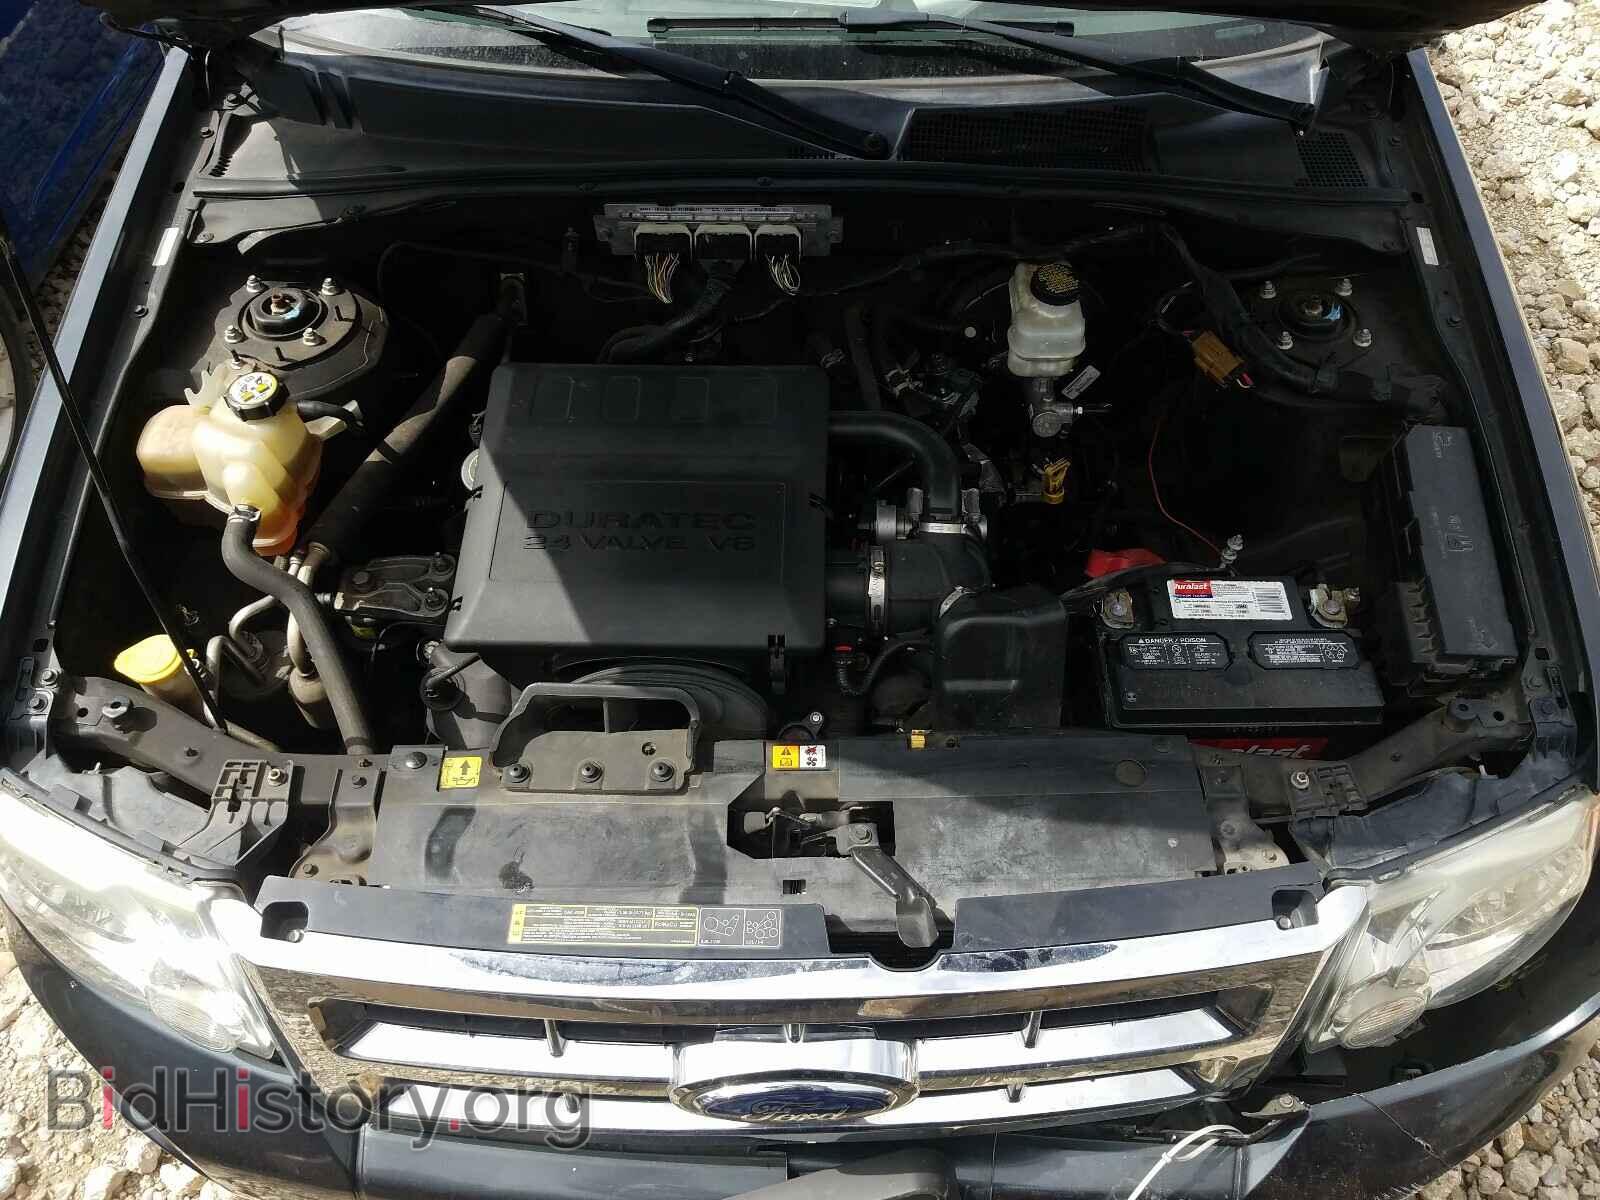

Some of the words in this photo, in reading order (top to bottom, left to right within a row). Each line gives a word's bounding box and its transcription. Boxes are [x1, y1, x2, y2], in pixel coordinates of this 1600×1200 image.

[526, 511, 756, 529] DURATEC
[523, 535, 570, 550] 24
[580, 535, 688, 550] VALVE
[706, 535, 755, 550] V6
[742, 1101, 850, 1121] Ford
